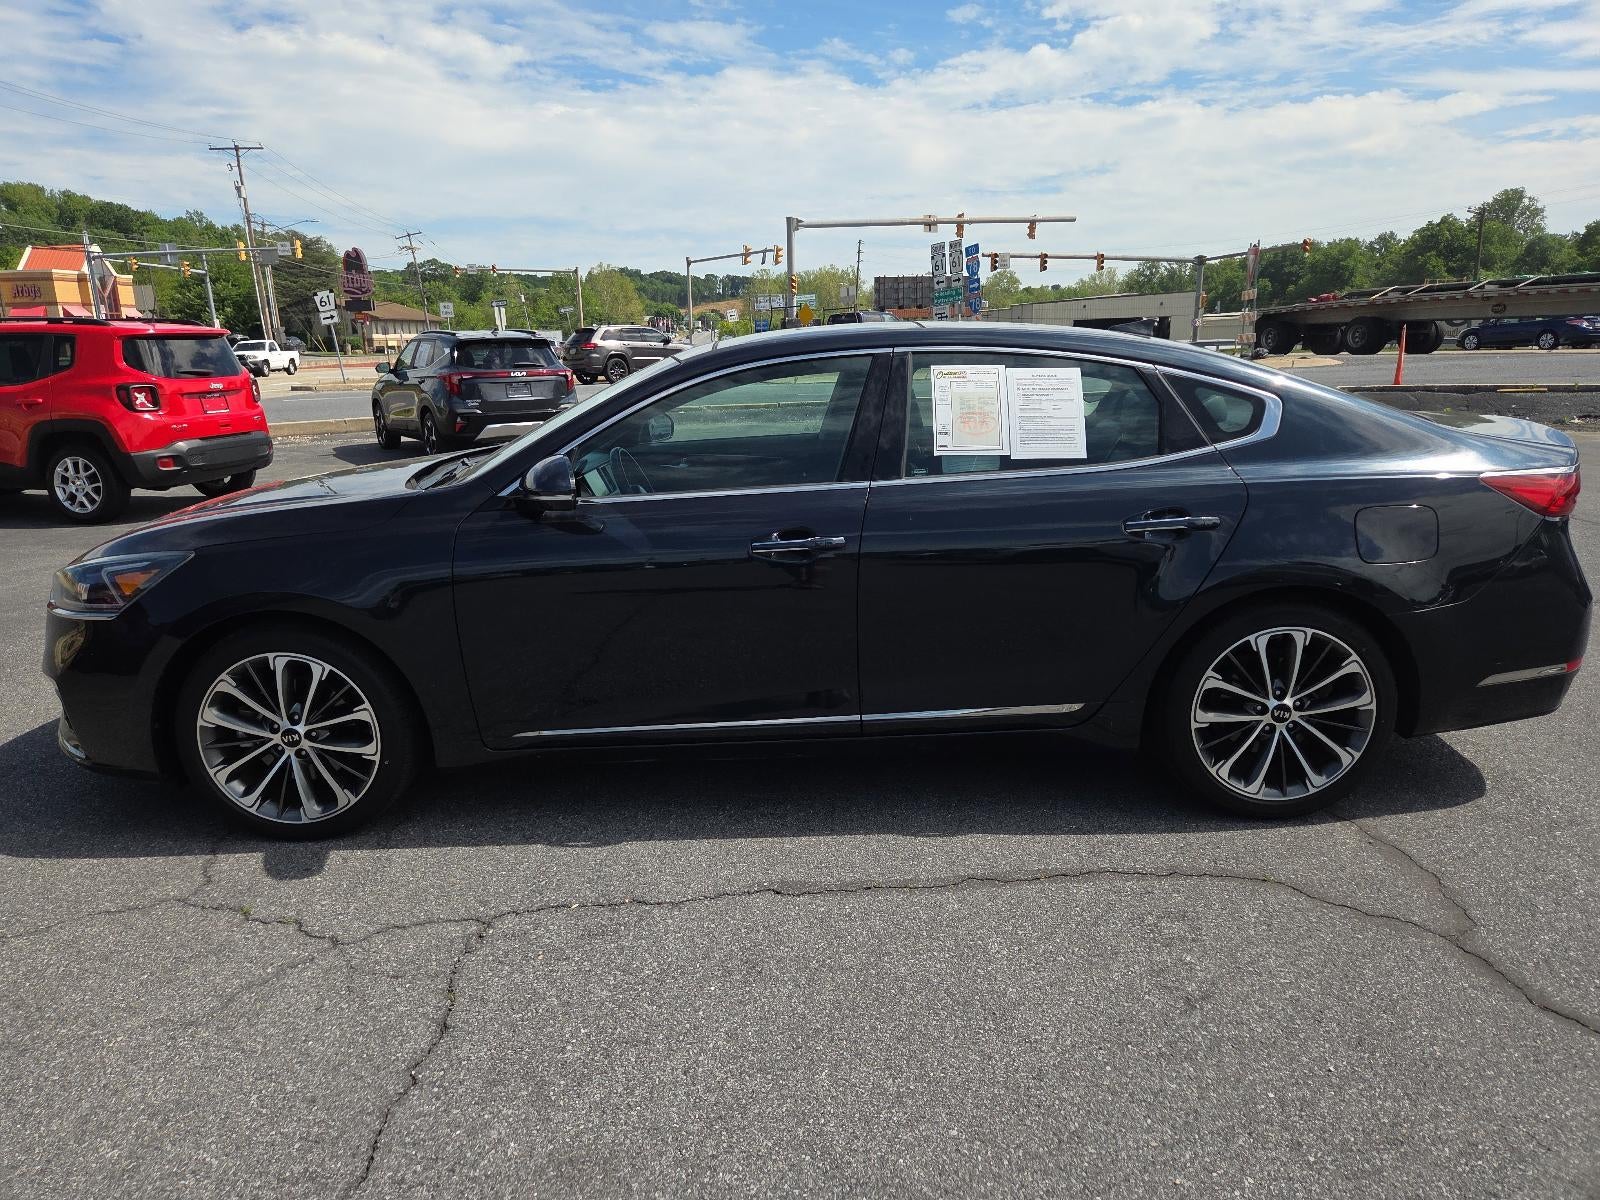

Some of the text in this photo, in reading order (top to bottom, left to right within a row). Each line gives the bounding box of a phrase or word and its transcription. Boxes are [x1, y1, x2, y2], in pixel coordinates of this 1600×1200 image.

[934, 258, 944, 271] 61
[951, 255, 961, 268] 61
[969, 261, 978, 274] 78
[13, 283, 41, 300] Arby's
[319, 295, 332, 307] 61
[970, 297, 981, 311] 78
[209, 382, 224, 390] Jeep
[1273, 709, 1290, 719] KIA
[282, 733, 300, 743] KIA
